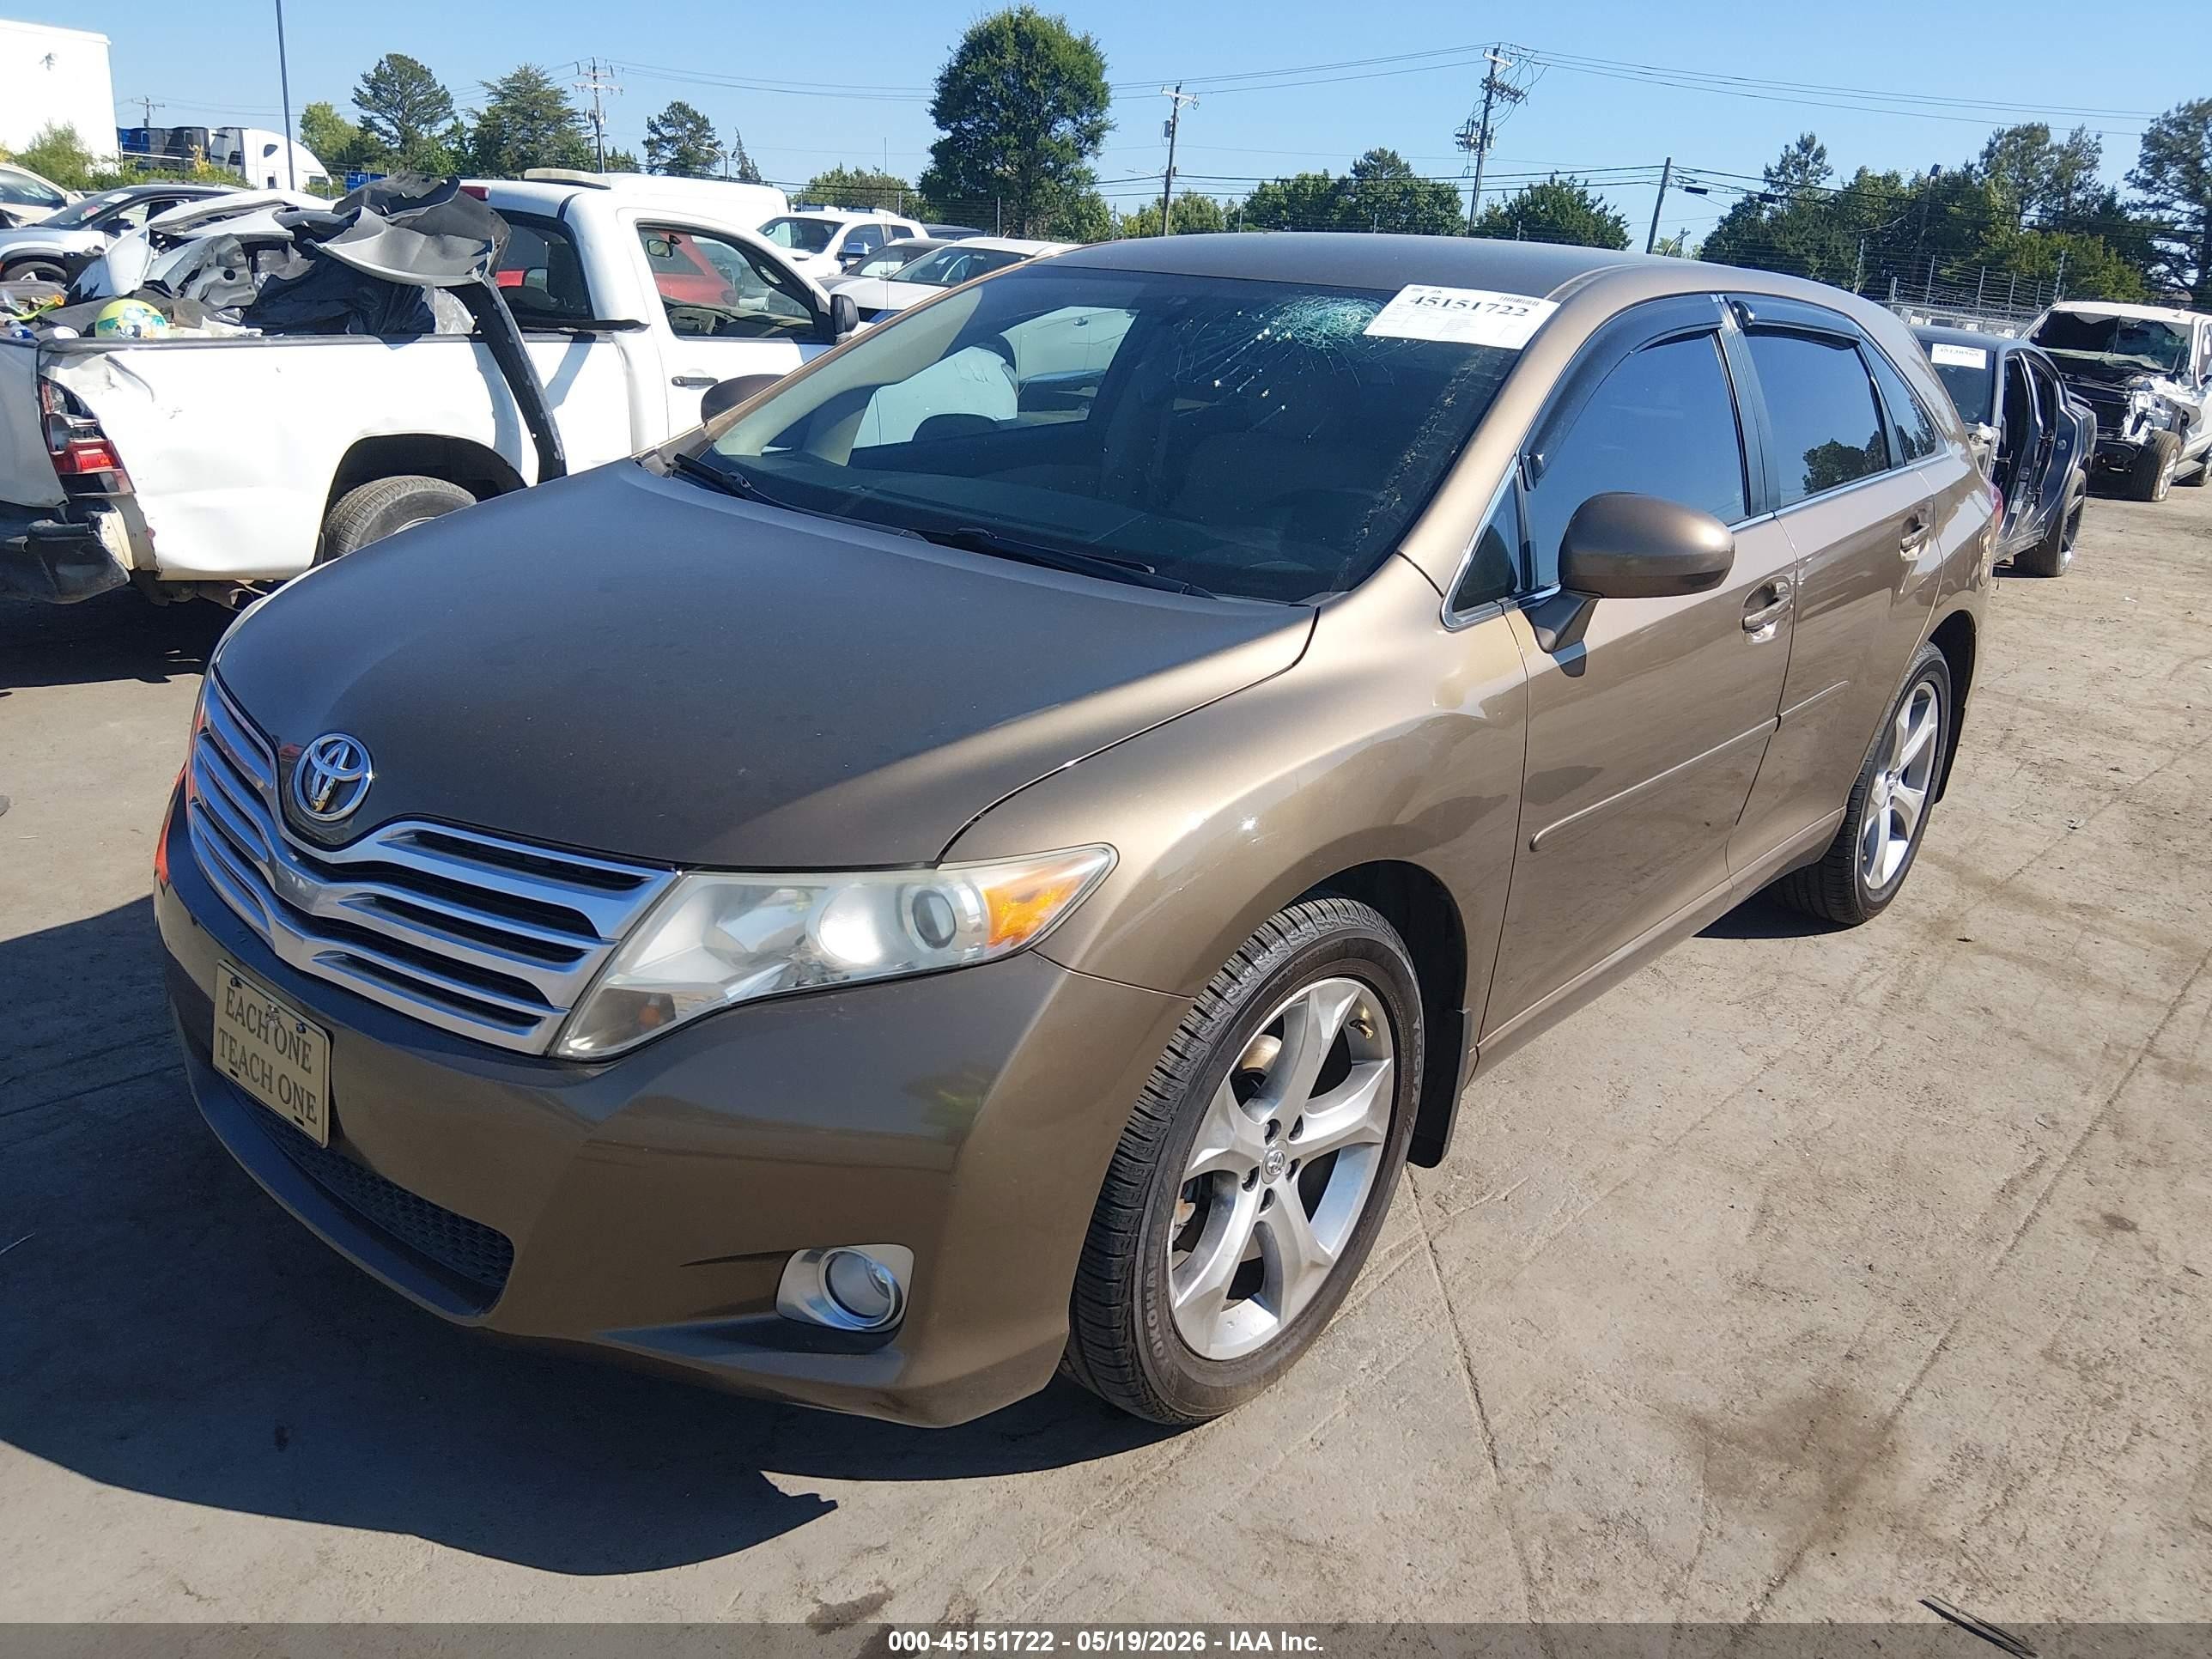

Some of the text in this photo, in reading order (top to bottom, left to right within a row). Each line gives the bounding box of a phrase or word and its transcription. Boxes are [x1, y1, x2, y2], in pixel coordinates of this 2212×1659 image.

[1409, 295, 1529, 317] 45151722
[225, 986, 312, 1074] EACH ONE
[219, 1027, 317, 1125] TEACH ONE
